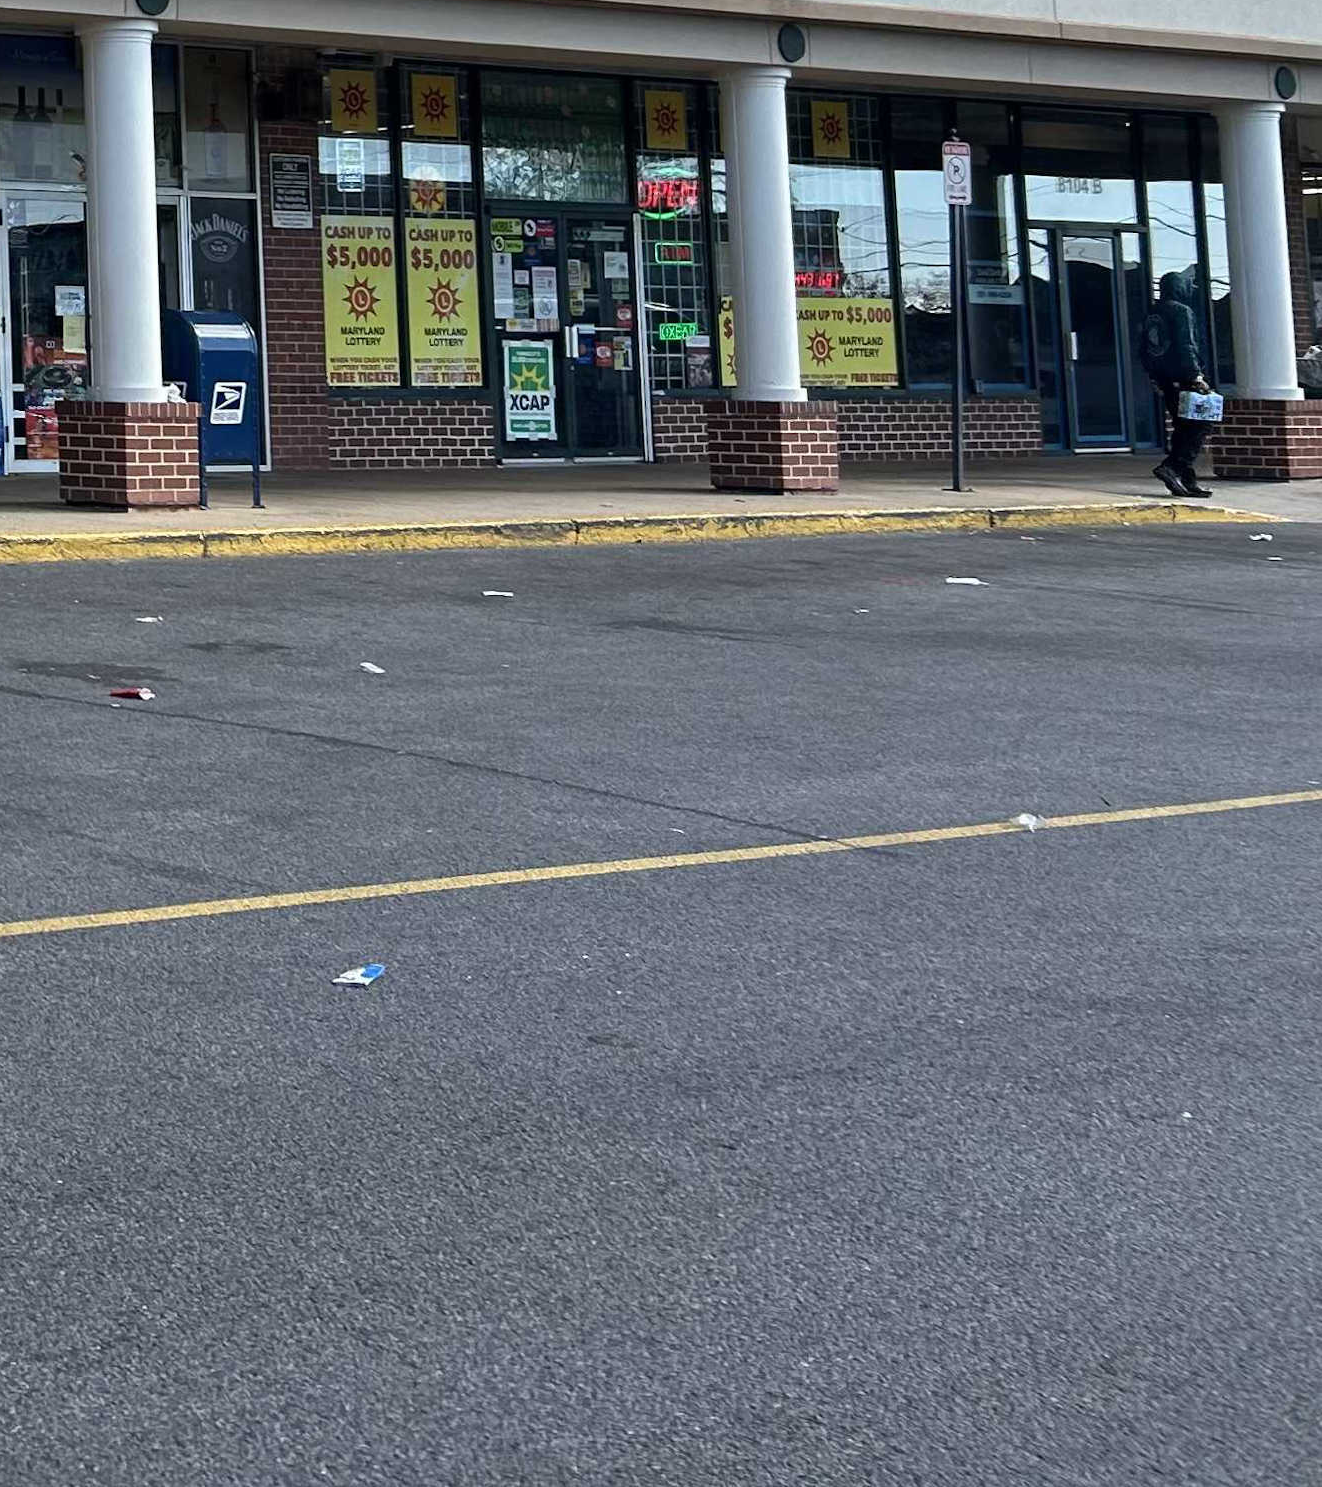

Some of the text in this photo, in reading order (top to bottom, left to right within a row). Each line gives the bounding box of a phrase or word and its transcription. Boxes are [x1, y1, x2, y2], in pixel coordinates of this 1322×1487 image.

[1057, 177, 1089, 194] 8104
[637, 180, 700, 209] OPEN
[325, 226, 391, 241] CASH UP TO
[409, 228, 473, 243] CASH UP TO
[327, 244, 393, 270] $5,000
[411, 246, 475, 272] $5,000
[818, 310, 830, 321] UP
[832, 310, 844, 321] TO
[846, 305, 892, 325] $5,000
[340, 326, 385, 336] MARYLAND
[424, 327, 468, 337] MARYLAND
[345, 337, 382, 346] LOTTERY
[429, 338, 464, 347] LOTTERY
[838, 336, 883, 346] MARYLAND
[844, 348, 880, 358] LOTTERY
[330, 372, 399, 384] FREE TICKETS
[509, 394, 550, 411] XCAP
